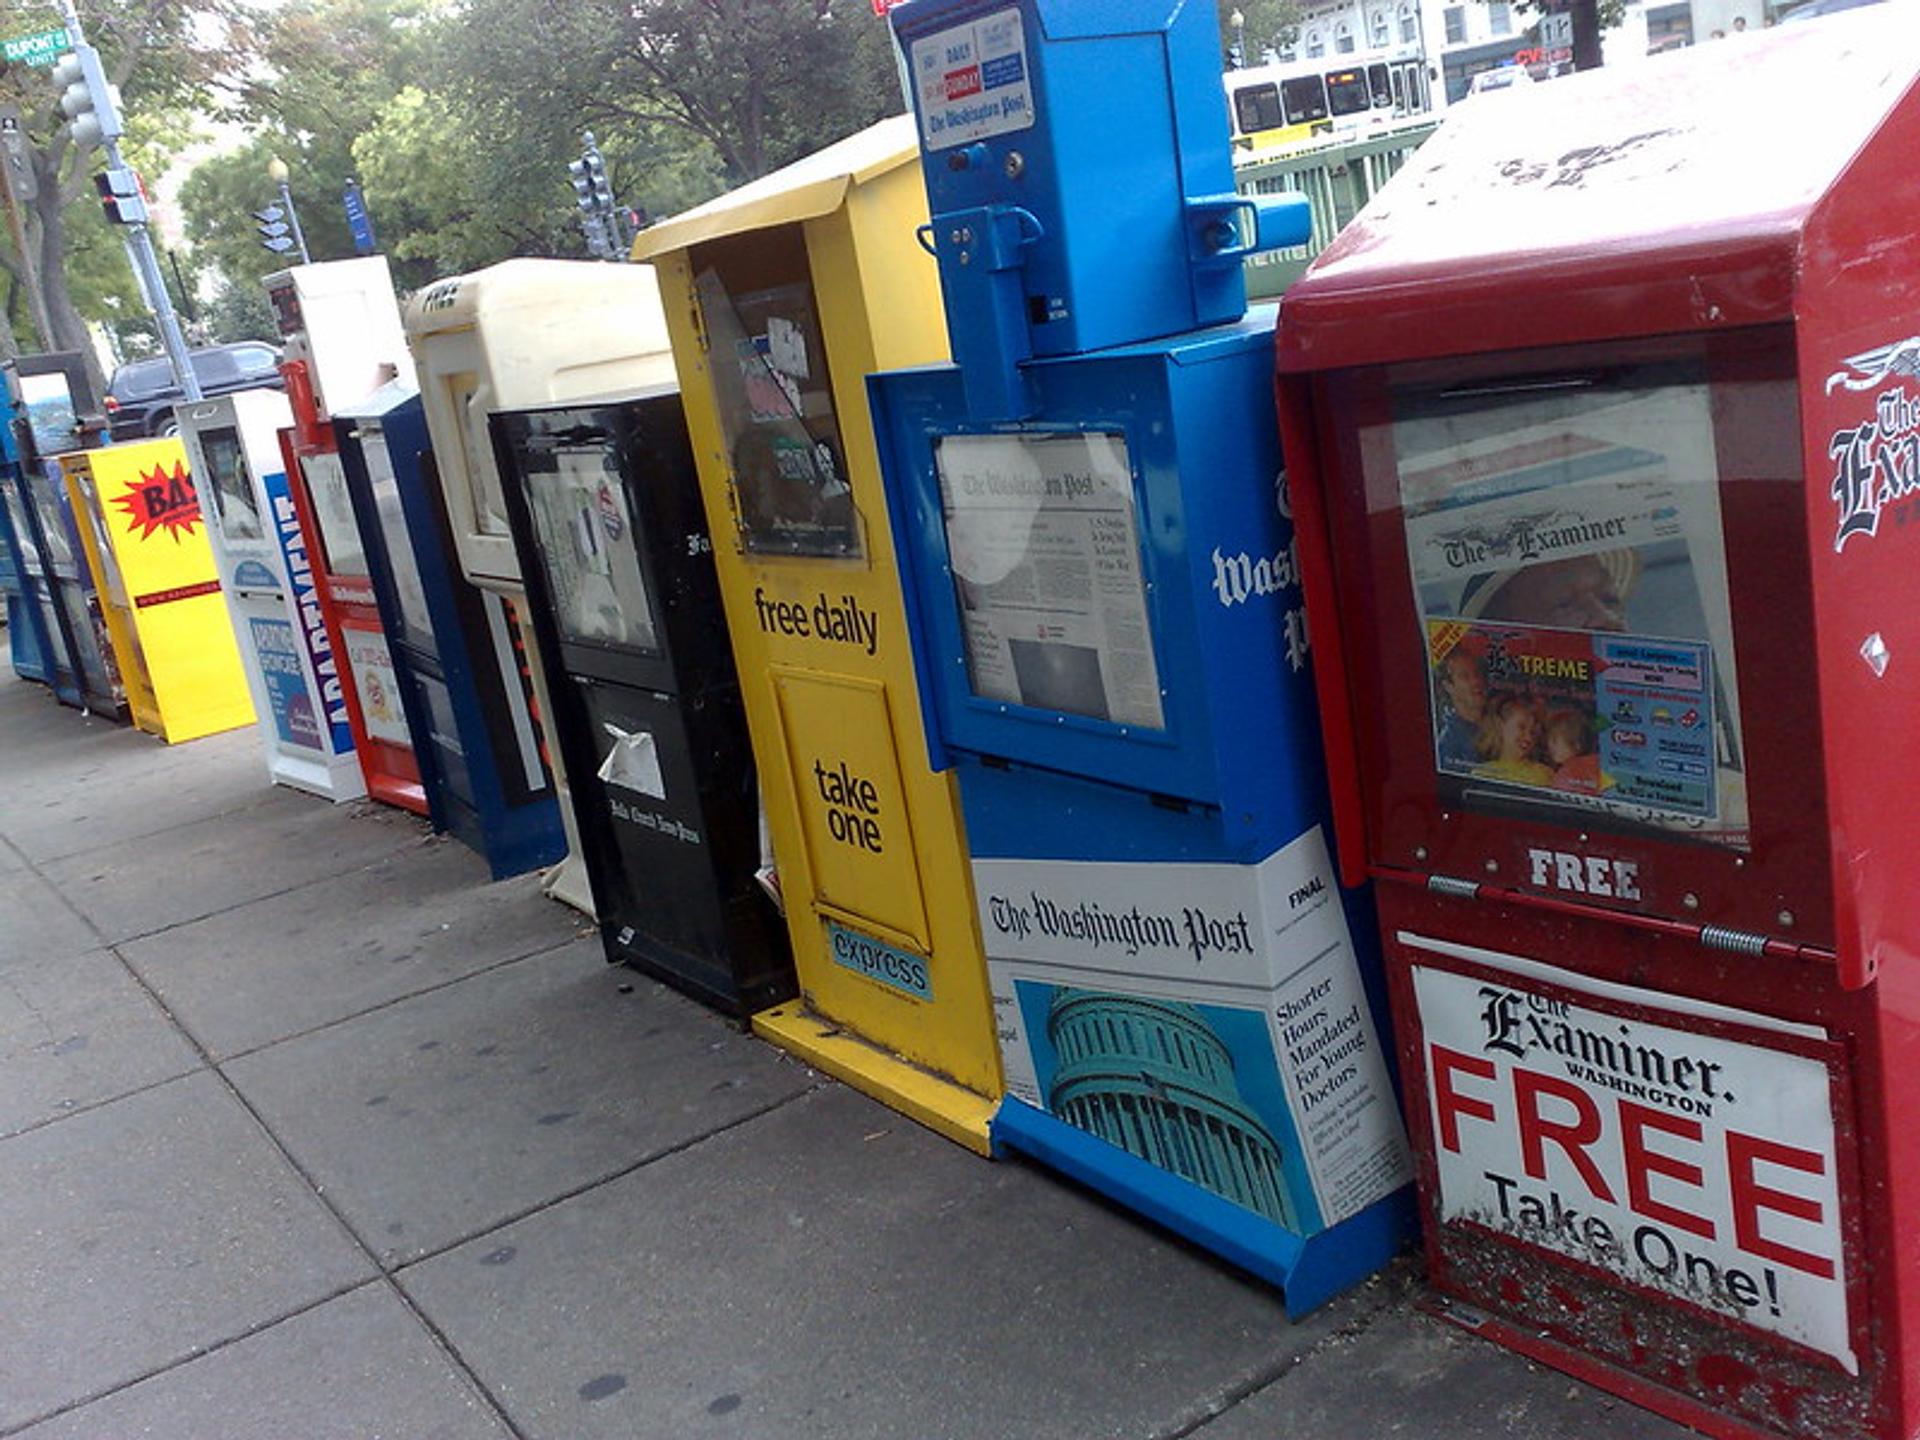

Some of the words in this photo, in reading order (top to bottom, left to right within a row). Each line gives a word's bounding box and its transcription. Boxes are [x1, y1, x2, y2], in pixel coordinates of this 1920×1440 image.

[1444, 541, 1485, 568] The
[1515, 510, 1628, 561] Examiner
[755, 587, 811, 638] free
[813, 592, 878, 656] daily
[814, 758, 880, 815] take
[827, 807, 883, 854] one
[1287, 876, 1326, 910] FINAL
[1528, 848, 1642, 902] FREE
[989, 894, 1033, 941] The
[1031, 891, 1181, 957] Washington
[1182, 906, 1255, 962] Post
[834, 933, 926, 991] express
[1276, 976, 1334, 1026] Shorter
[1281, 1007, 1329, 1049] Hours
[1288, 1006, 1362, 1070] Mandated
[1295, 1062, 1322, 1091] For
[1319, 1030, 1368, 1074] Young
[1478, 986, 1735, 1103] Examiner.
[1300, 1062, 1358, 1114] Doctors
[1564, 1060, 1712, 1117] WASHINGTON
[1429, 1043, 1836, 1280] FREE
[1484, 1171, 1615, 1252] Take
[1632, 1226, 1782, 1317] One!
